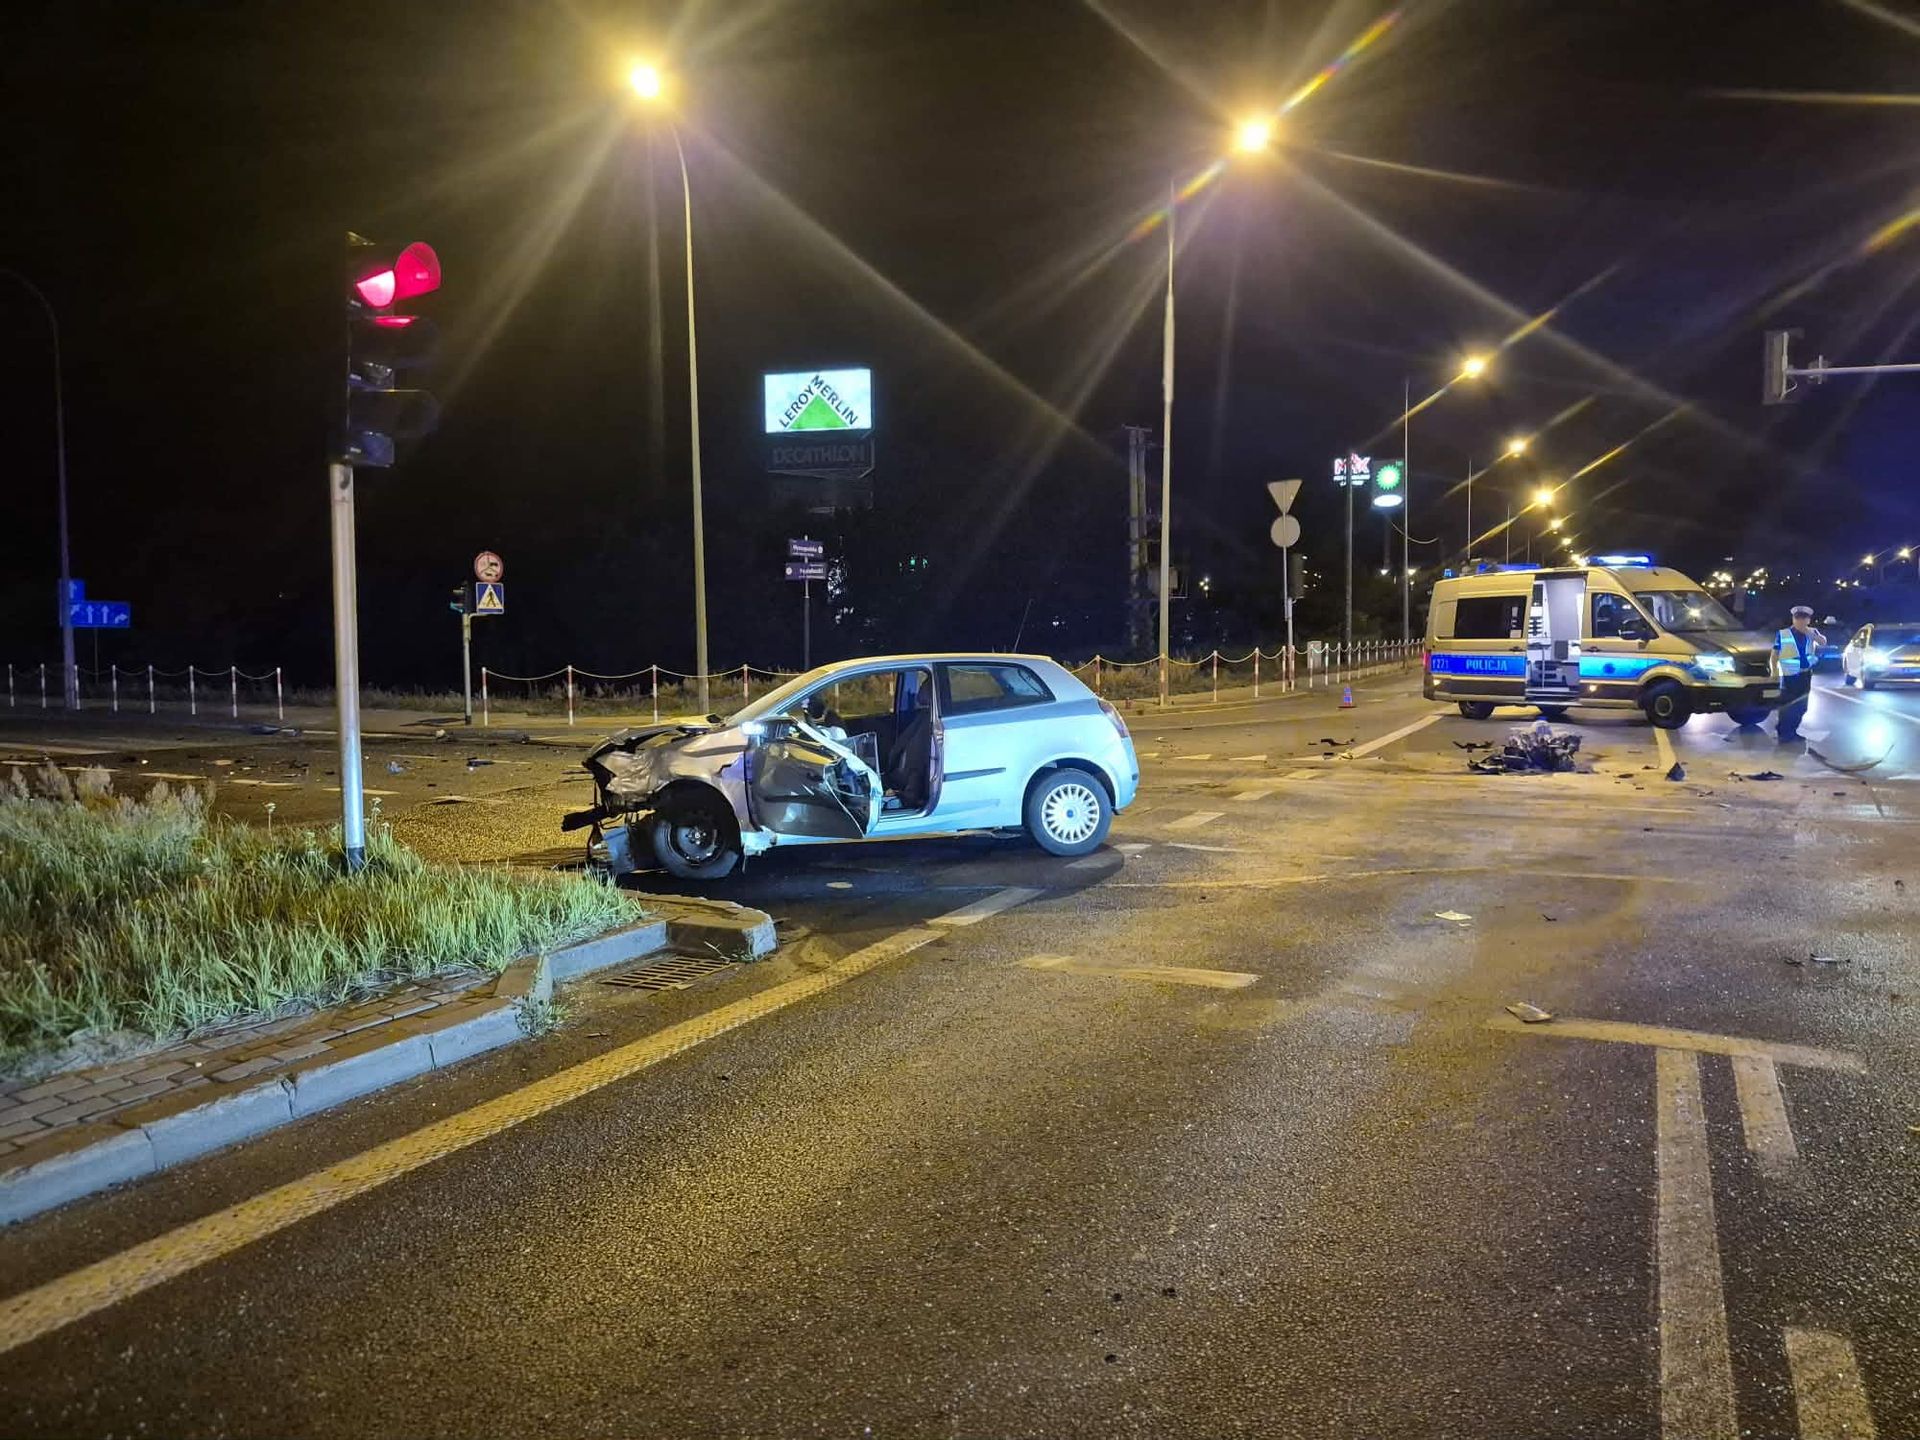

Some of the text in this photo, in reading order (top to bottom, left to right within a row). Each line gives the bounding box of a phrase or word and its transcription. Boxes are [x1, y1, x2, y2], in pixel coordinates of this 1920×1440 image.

[778, 374, 859, 428] LEROY MERLIN
[1465, 658, 1508, 671] POLICJA
